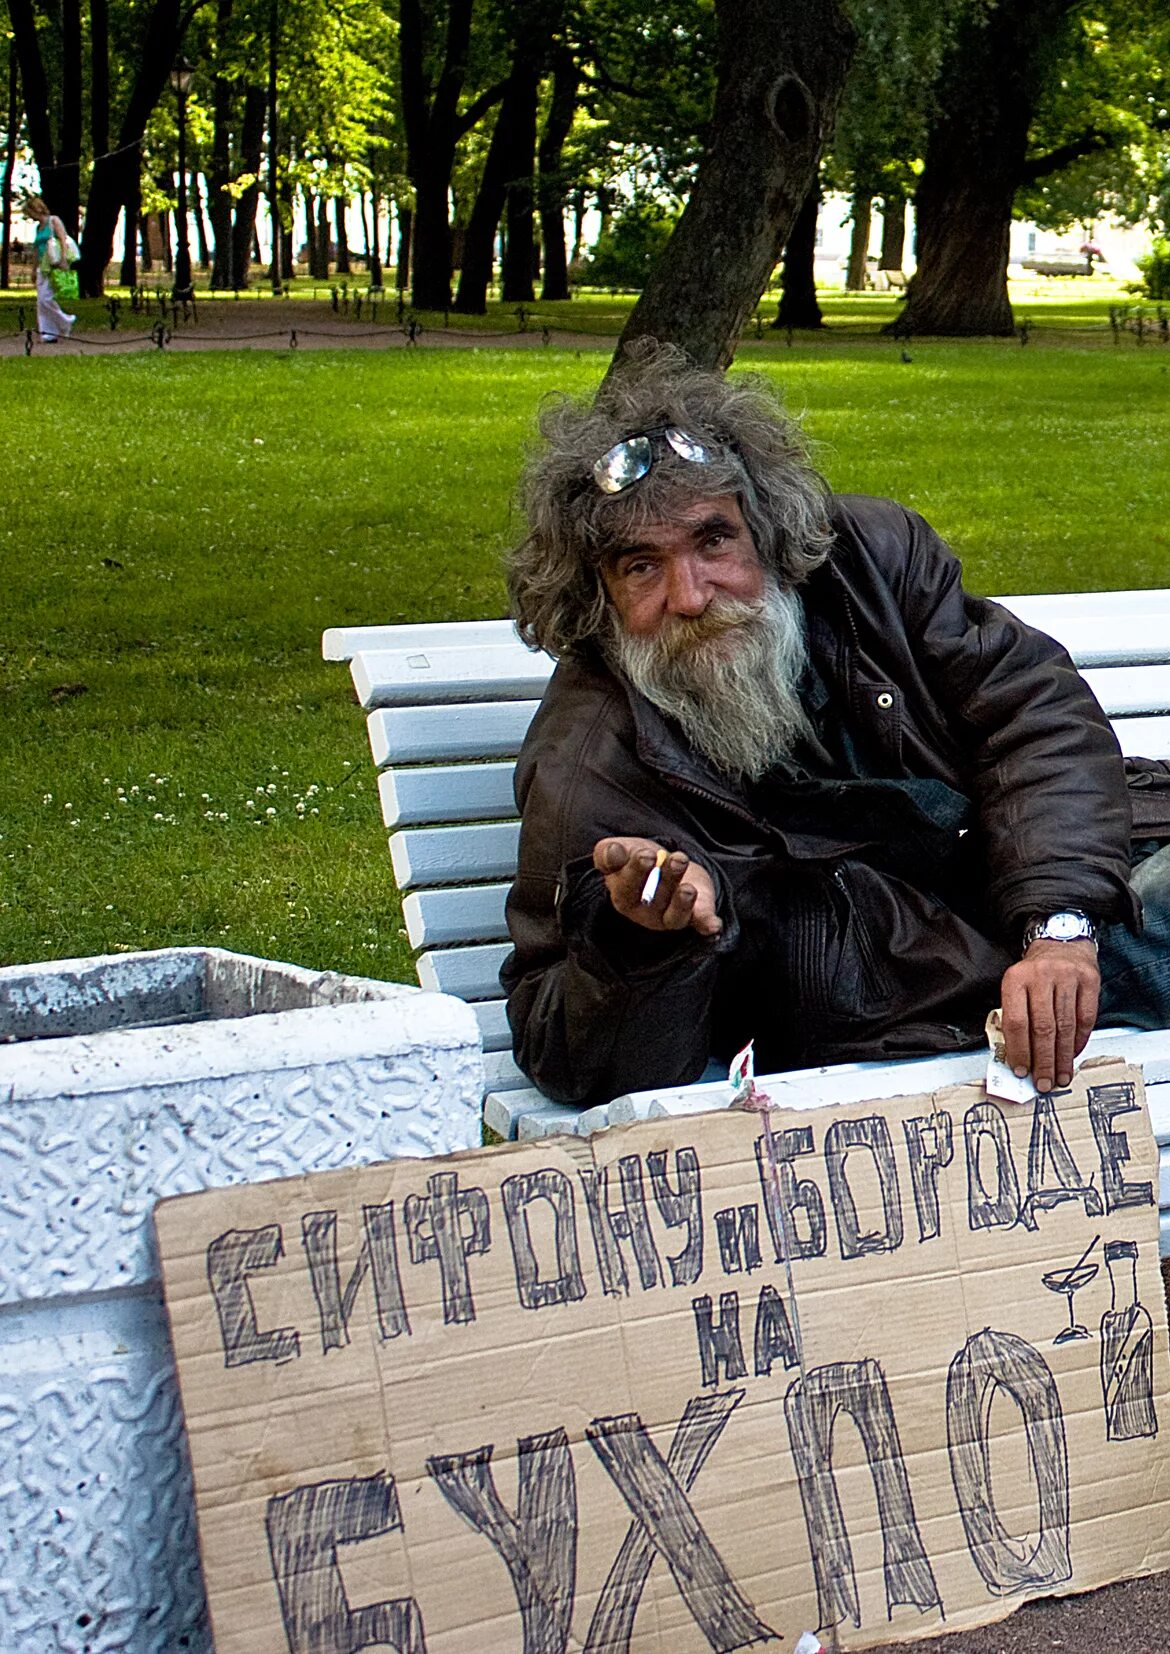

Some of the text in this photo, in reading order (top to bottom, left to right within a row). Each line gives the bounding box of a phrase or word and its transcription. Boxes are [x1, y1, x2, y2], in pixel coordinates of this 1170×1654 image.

[207, 1146, 705, 1368] СИФОНУ
[754, 1081, 1154, 1264] БОРОДЕ
[692, 1284, 802, 1387] НА
